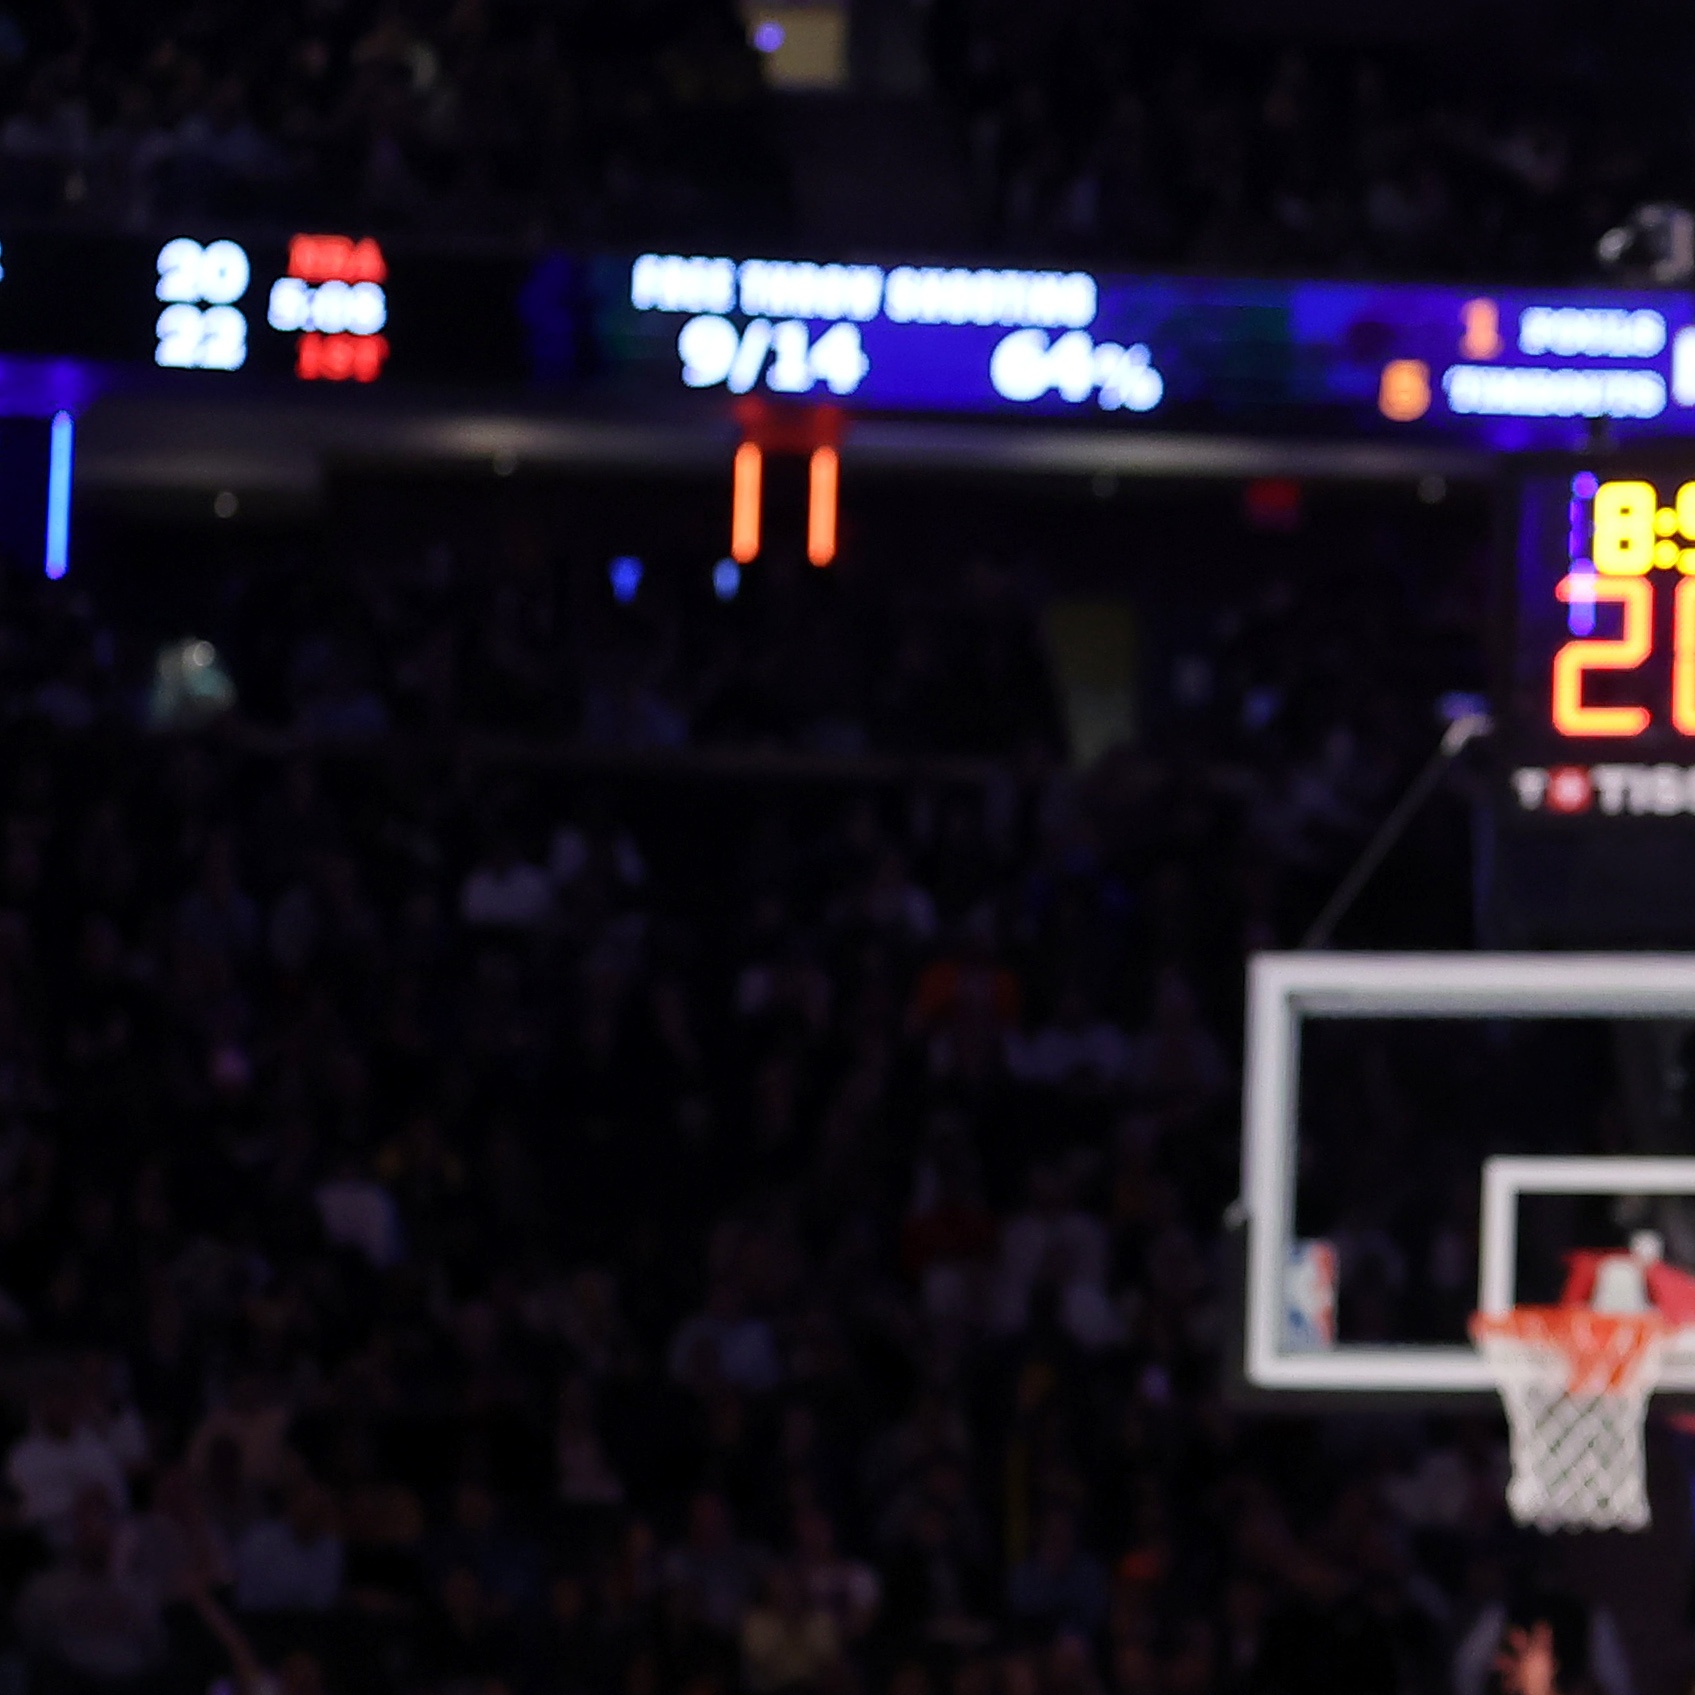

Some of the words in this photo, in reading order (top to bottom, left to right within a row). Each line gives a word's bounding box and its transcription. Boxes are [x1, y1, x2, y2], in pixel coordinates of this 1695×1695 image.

[155, 238, 250, 304] 20
[155, 304, 248, 370] 22
[678, 314, 869, 395] 9/14
[990, 328, 1164, 411] 64%
